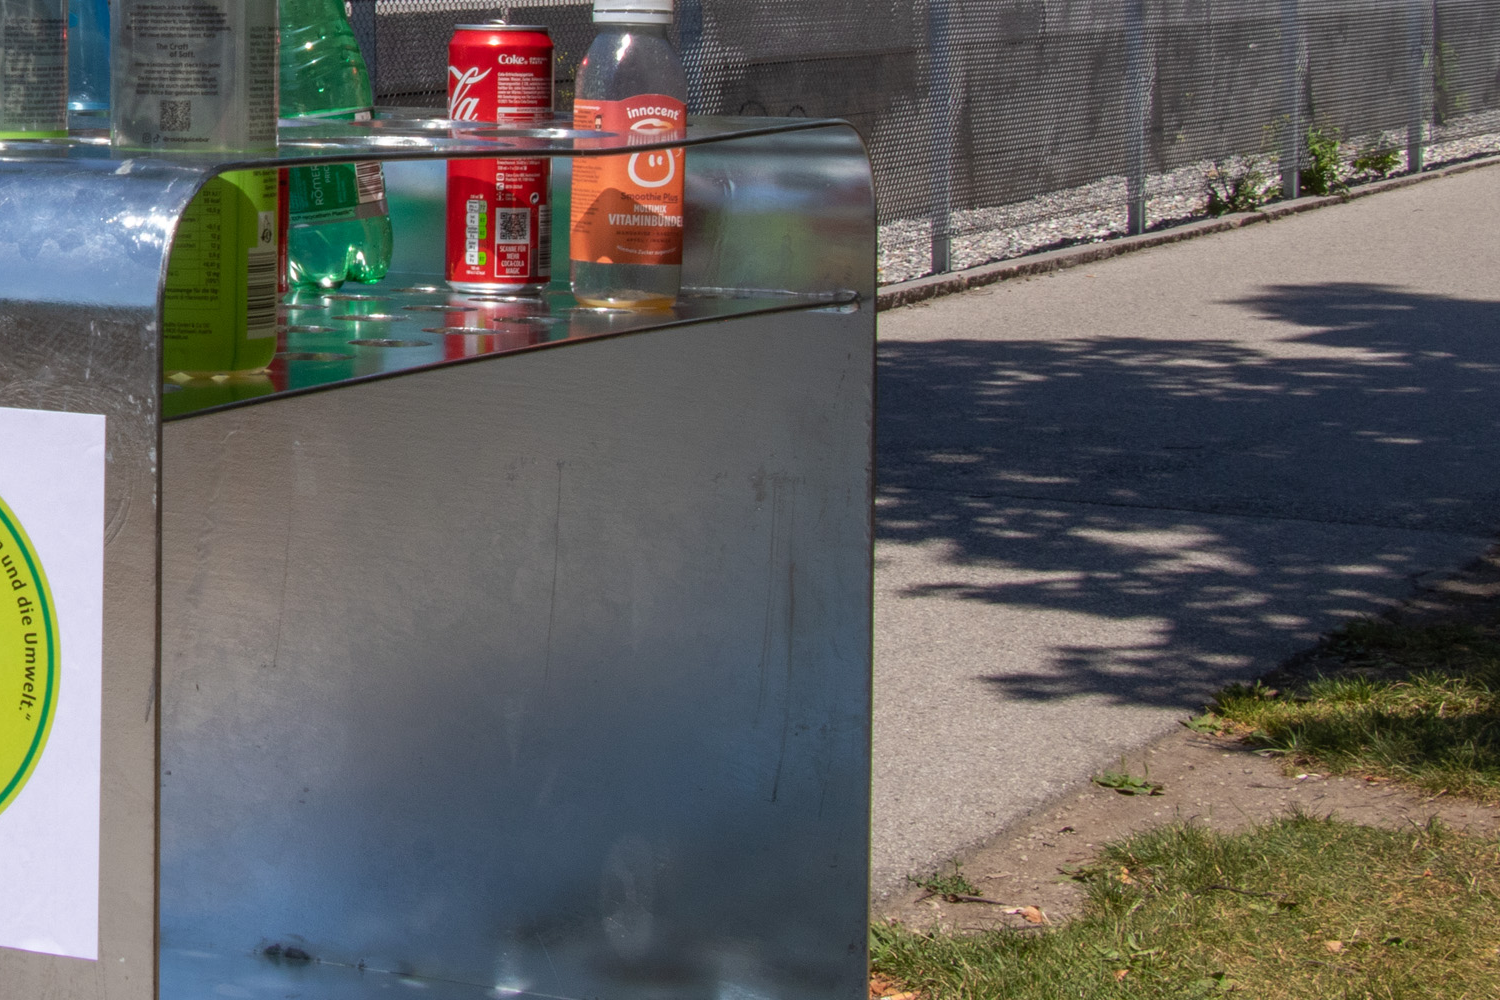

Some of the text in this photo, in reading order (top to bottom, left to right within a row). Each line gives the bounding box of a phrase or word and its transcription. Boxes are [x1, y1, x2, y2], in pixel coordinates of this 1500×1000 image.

[626, 105, 679, 120] innocent
[620, 192, 678, 202] Smoothie Plus
[634, 203, 667, 213] MULTIMIX
[1, 554, 28, 591] und
[16, 596, 34, 626] die
